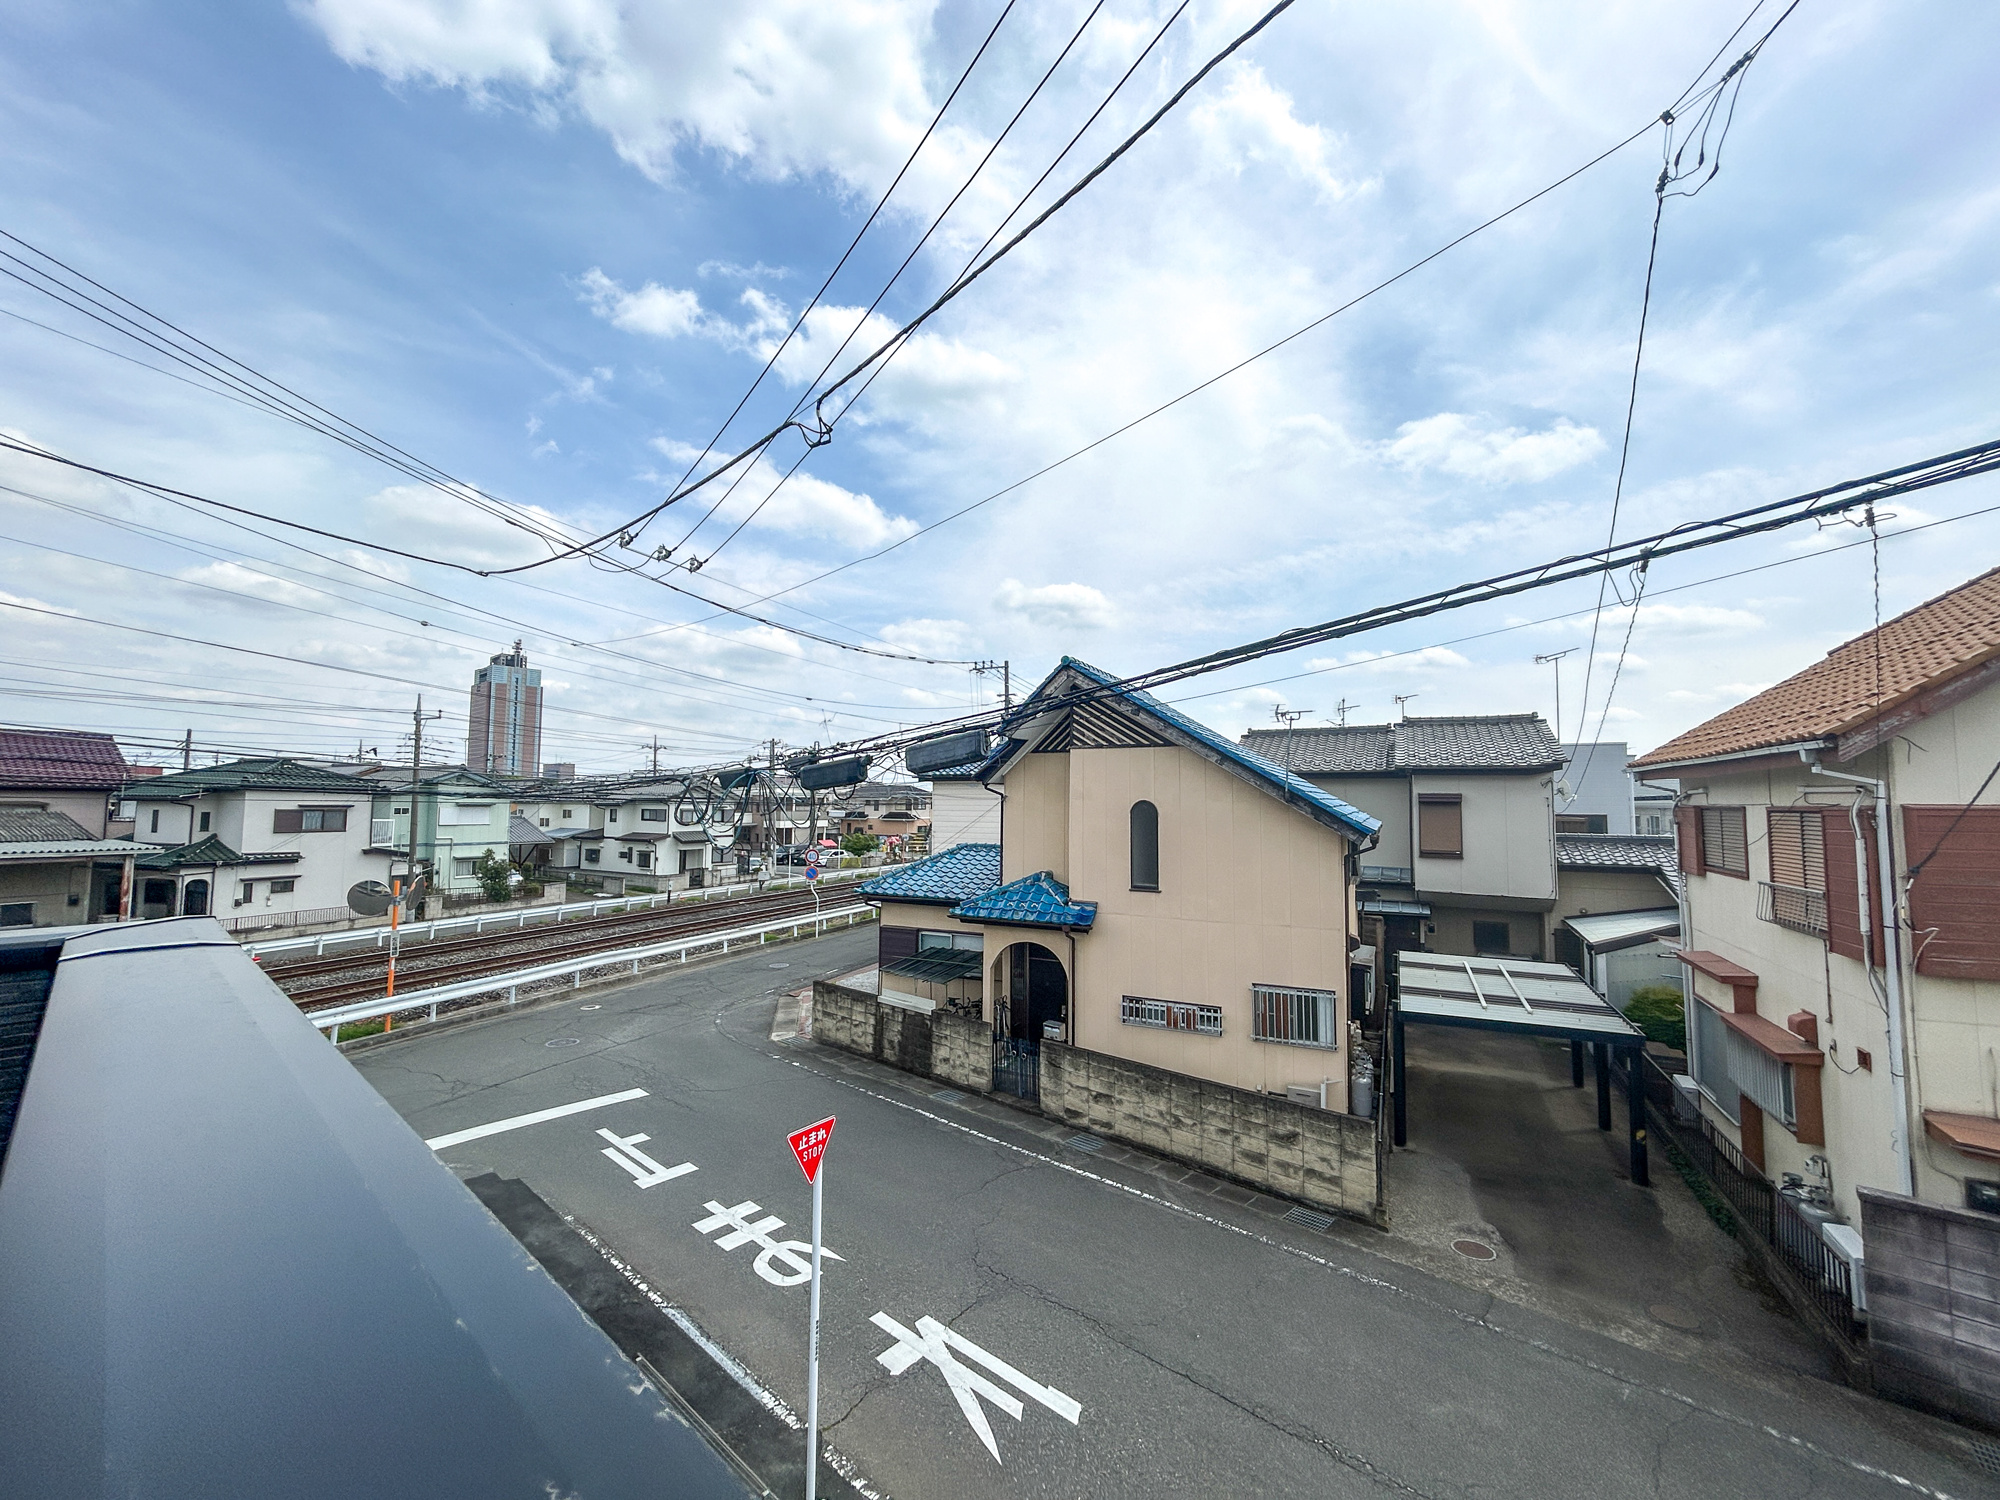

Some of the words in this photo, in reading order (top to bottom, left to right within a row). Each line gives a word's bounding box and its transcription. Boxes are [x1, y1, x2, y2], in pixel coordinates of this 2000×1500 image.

[808, 852, 817, 860] 40
[798, 1127, 827, 1151] 止まれ
[803, 1144, 823, 1162] STOP
[594, 1127, 1082, 1466] 止まれ
